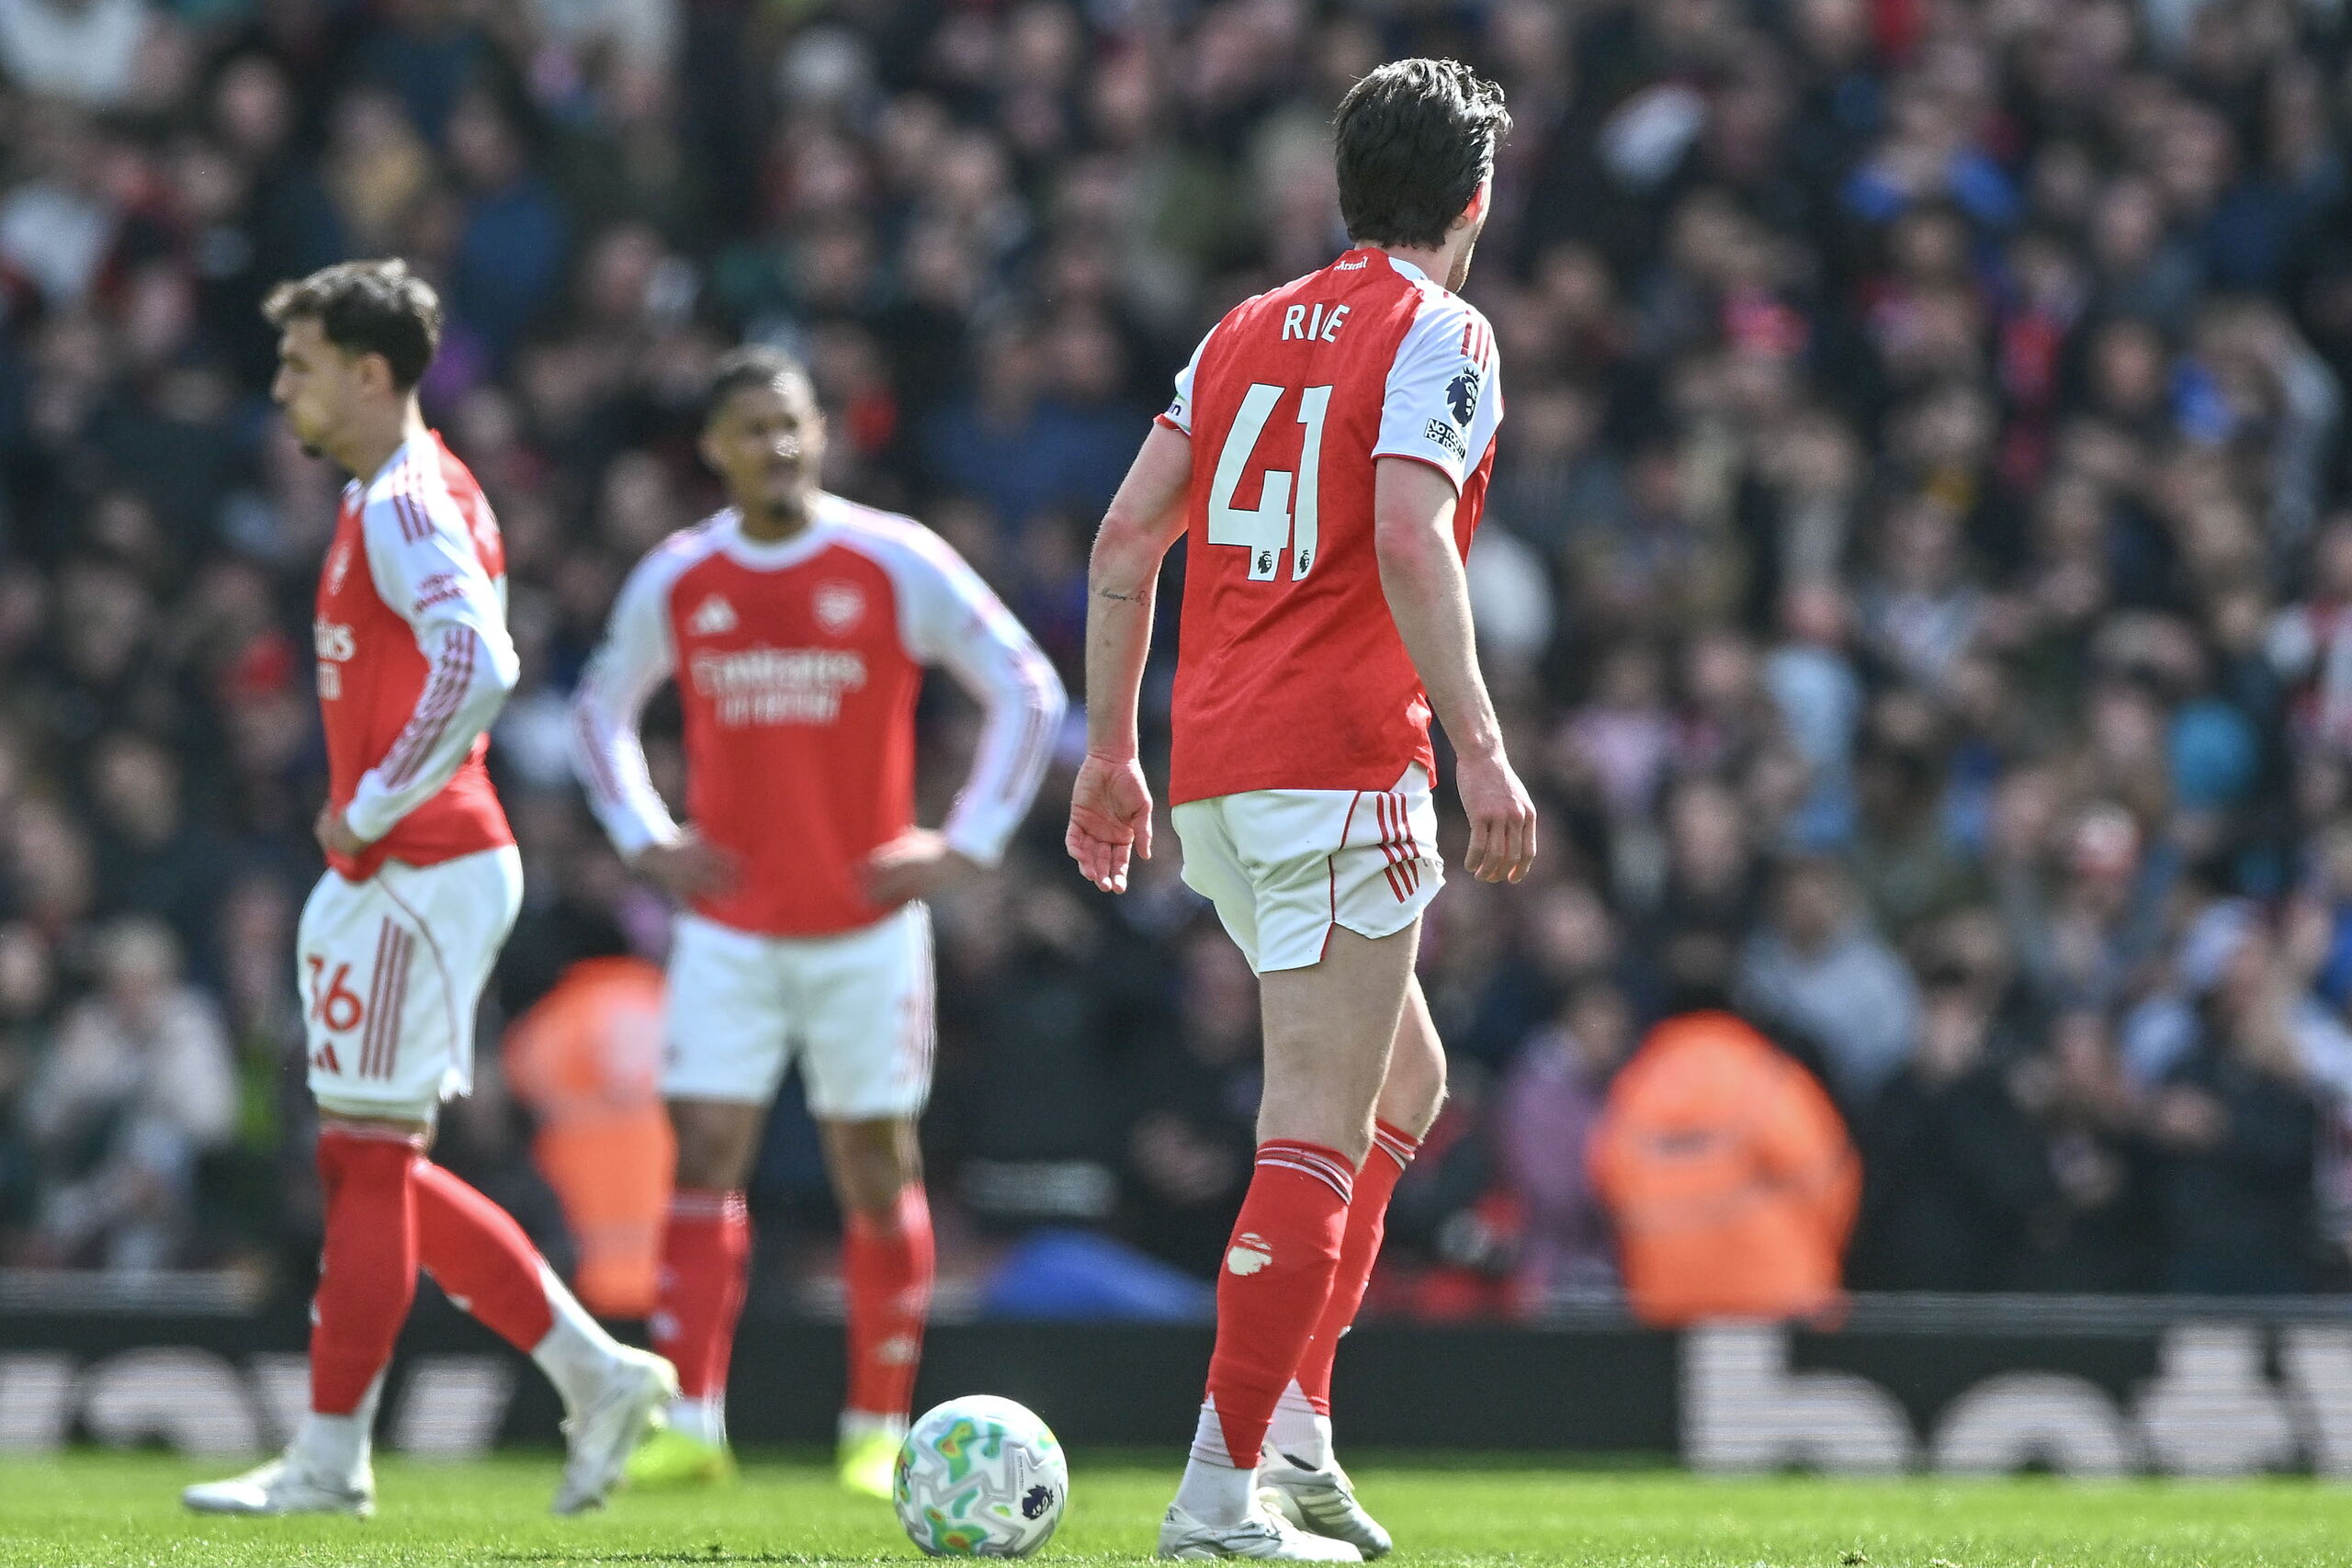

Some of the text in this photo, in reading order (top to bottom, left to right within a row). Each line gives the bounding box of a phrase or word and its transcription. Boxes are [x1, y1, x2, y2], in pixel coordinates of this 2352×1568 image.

[1282, 303, 1351, 343] RIE
[1427, 419, 1445, 434] No
[1208, 382, 1334, 582] 41
